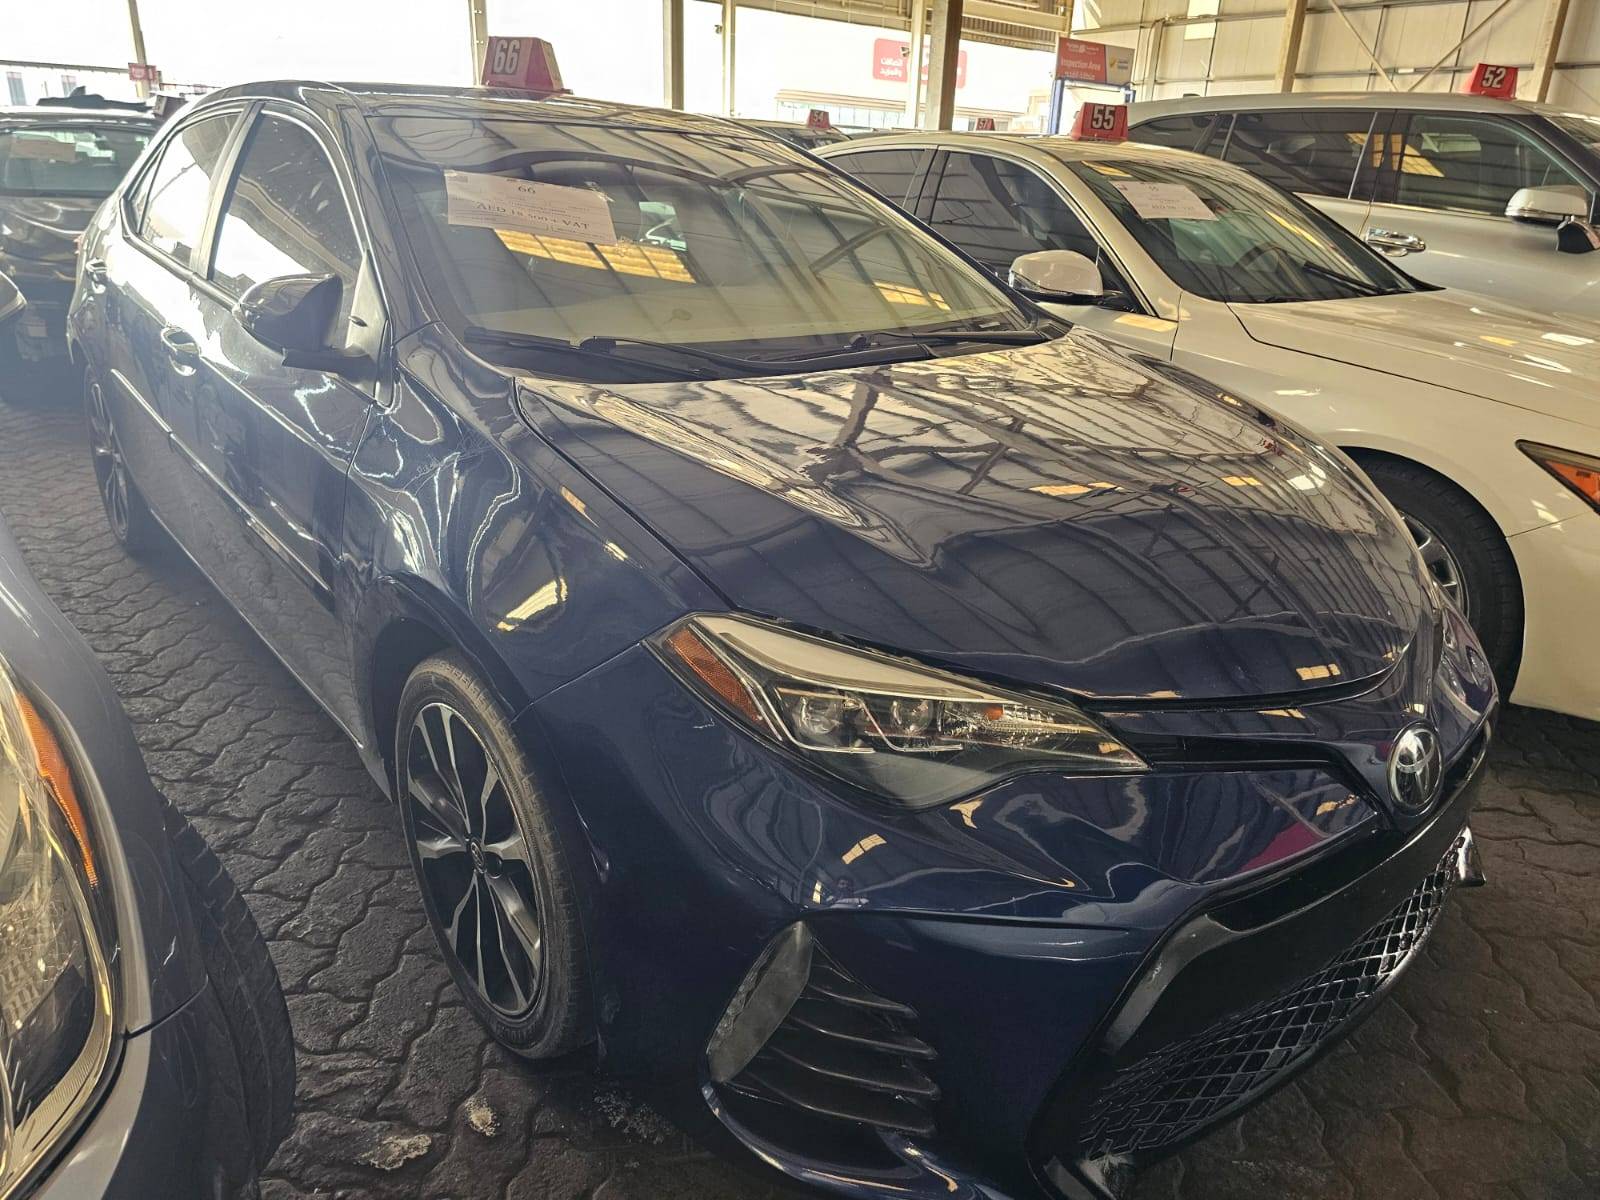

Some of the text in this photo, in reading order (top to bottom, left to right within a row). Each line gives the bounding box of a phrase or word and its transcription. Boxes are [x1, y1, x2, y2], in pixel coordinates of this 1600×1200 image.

[493, 39, 521, 74] 66
[1482, 66, 1506, 88] 52
[1092, 104, 1115, 130] 55
[518, 185, 537, 195] 66
[476, 201, 507, 213] AED
[562, 219, 590, 230] VAT
